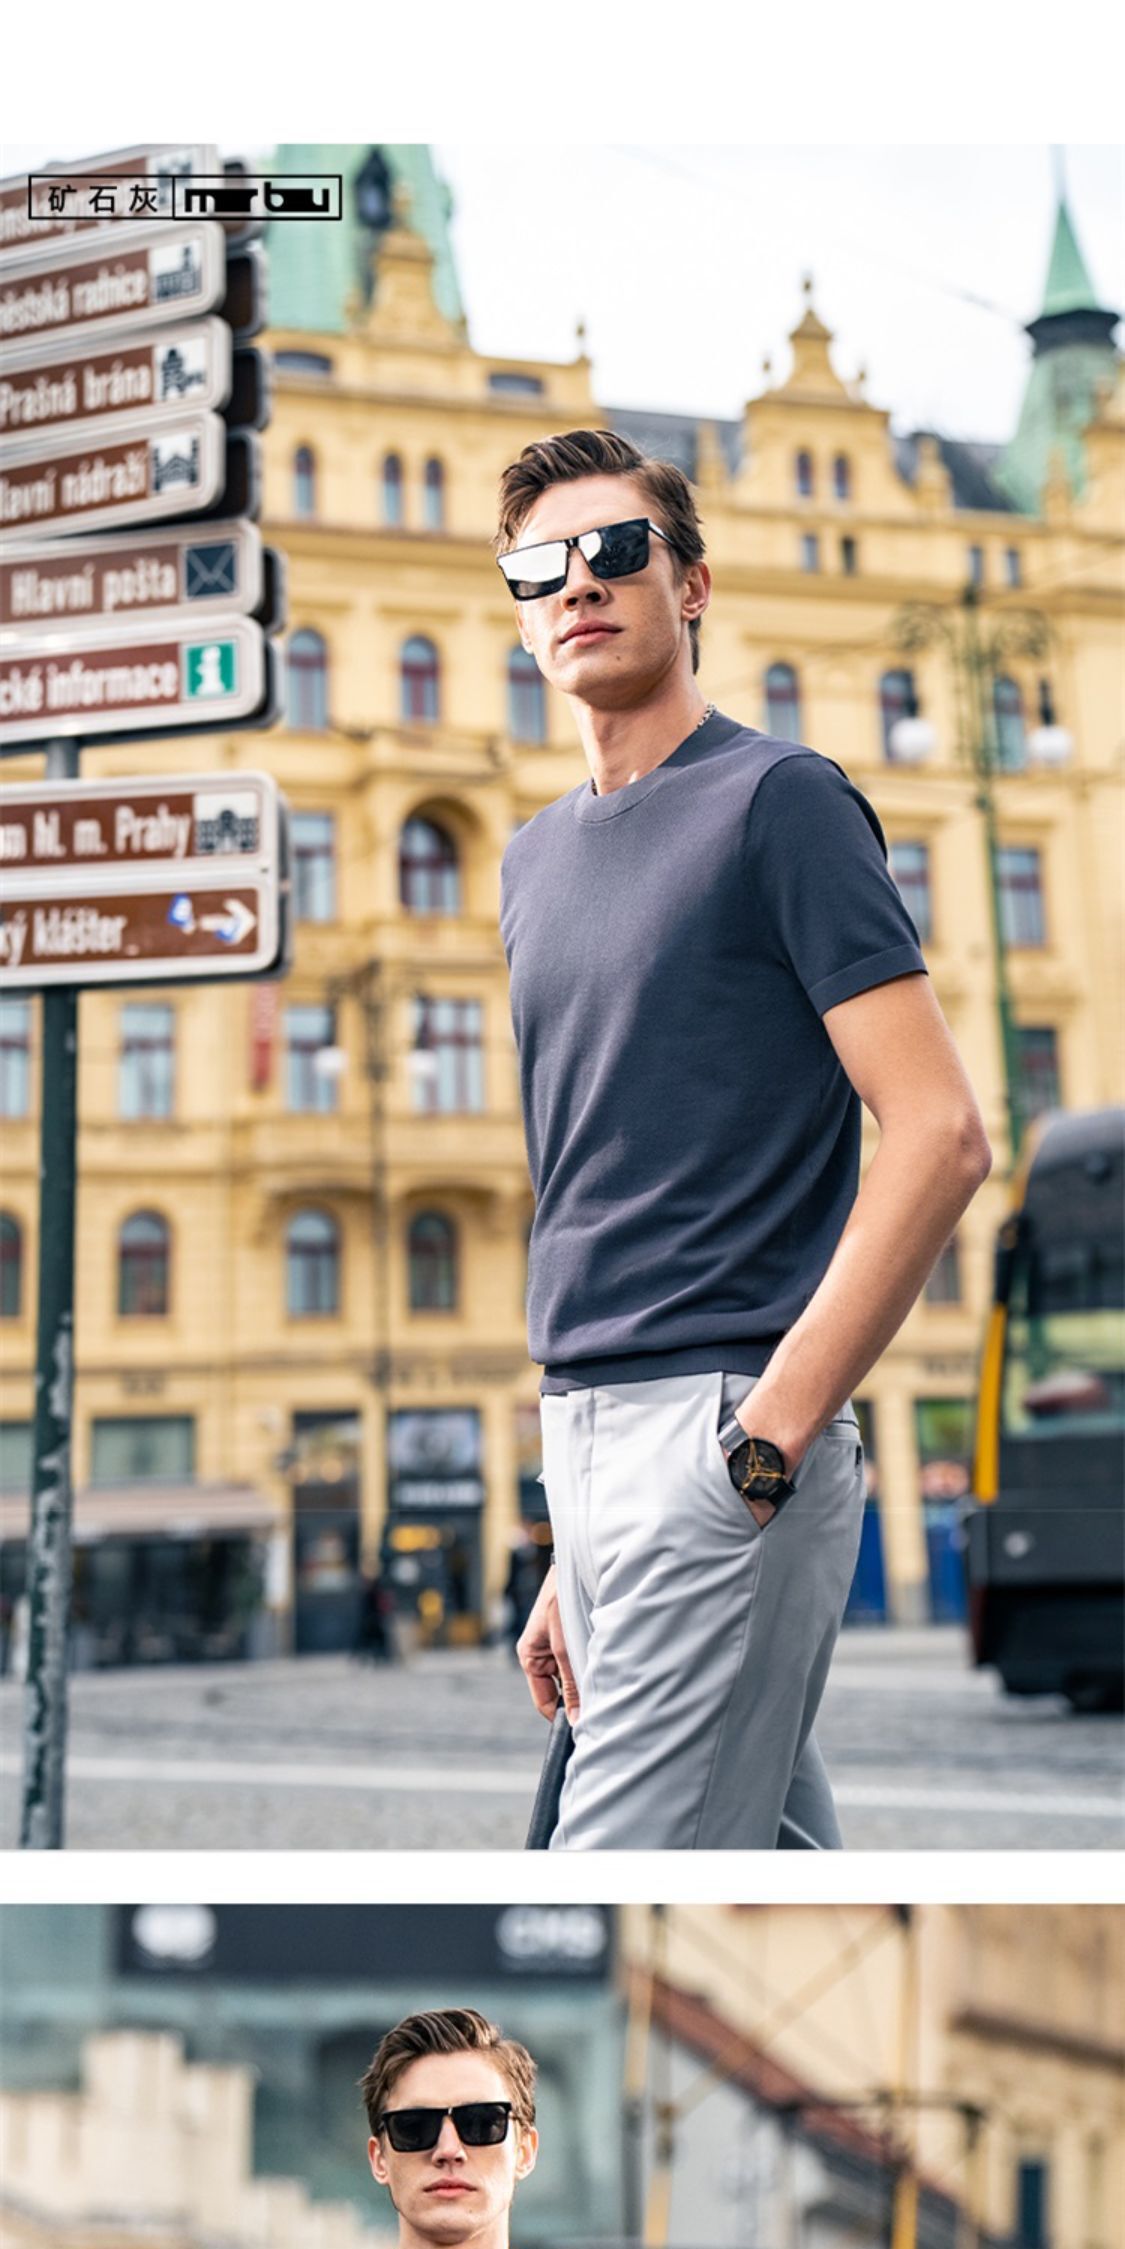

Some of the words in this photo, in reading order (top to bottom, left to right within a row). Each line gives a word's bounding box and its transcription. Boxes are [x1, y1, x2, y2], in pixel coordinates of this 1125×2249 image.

[0, 275, 70, 334] ěstská
[71, 263, 148, 318] radnice
[83, 360, 150, 411] brána
[60, 450, 148, 510] nádraží
[10, 562, 95, 616] Hlavní
[102, 557, 178, 614] pošta
[46, 659, 178, 710] informace
[33, 810, 67, 859] hl.
[73, 818, 108, 856] m.
[115, 803, 192, 863] Prahy
